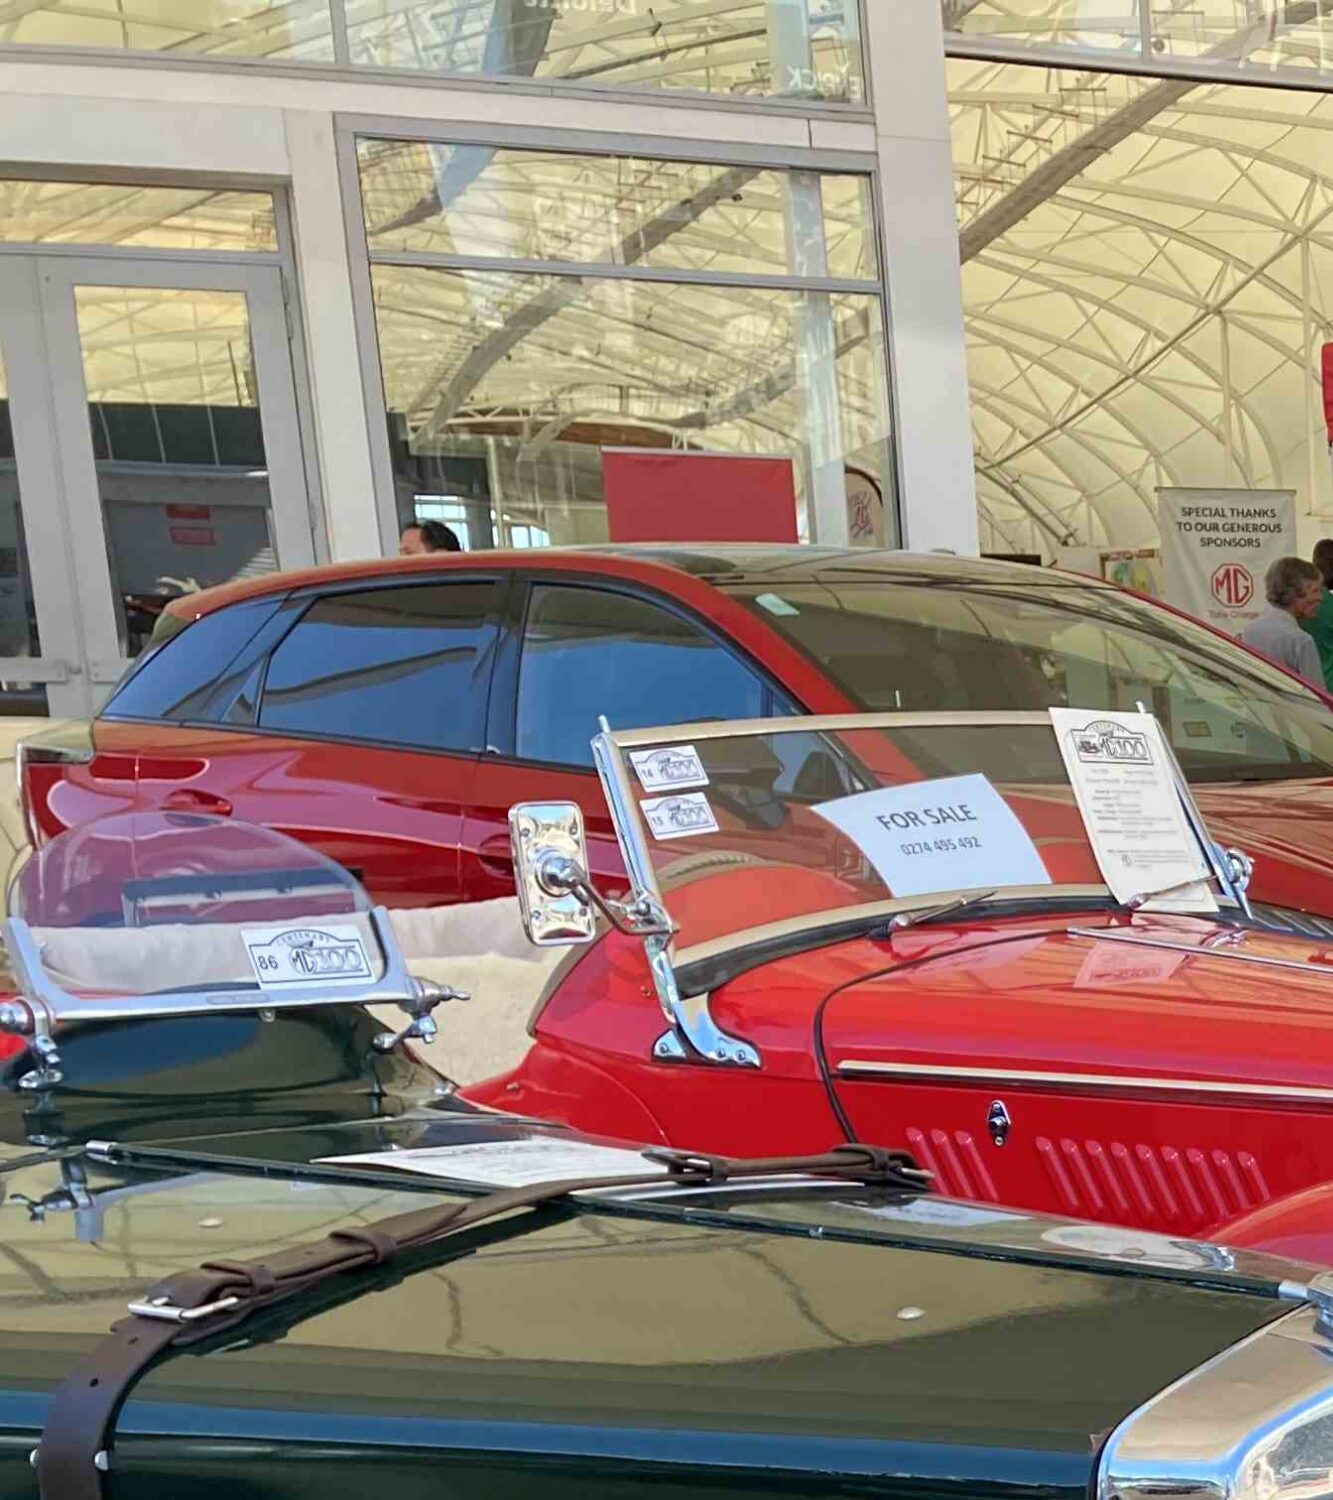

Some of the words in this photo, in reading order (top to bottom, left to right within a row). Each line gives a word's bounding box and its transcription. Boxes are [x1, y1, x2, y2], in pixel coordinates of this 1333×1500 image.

[1181, 506, 1228, 518] SPECIAL
[1230, 507, 1277, 518] THANKS
[1176, 521, 1193, 532] TO
[1194, 522, 1220, 533] OUR
[1221, 522, 1283, 534] GENEROUS
[1199, 537, 1262, 548] SPONSORS
[1215, 567, 1250, 604] MG
[875, 810, 927, 831] FOR
[923, 804, 978, 825] SALE
[900, 841, 934, 856] 0274
[933, 839, 957, 851] 495
[957, 836, 982, 849] 492
[257, 955, 279, 971] 86
